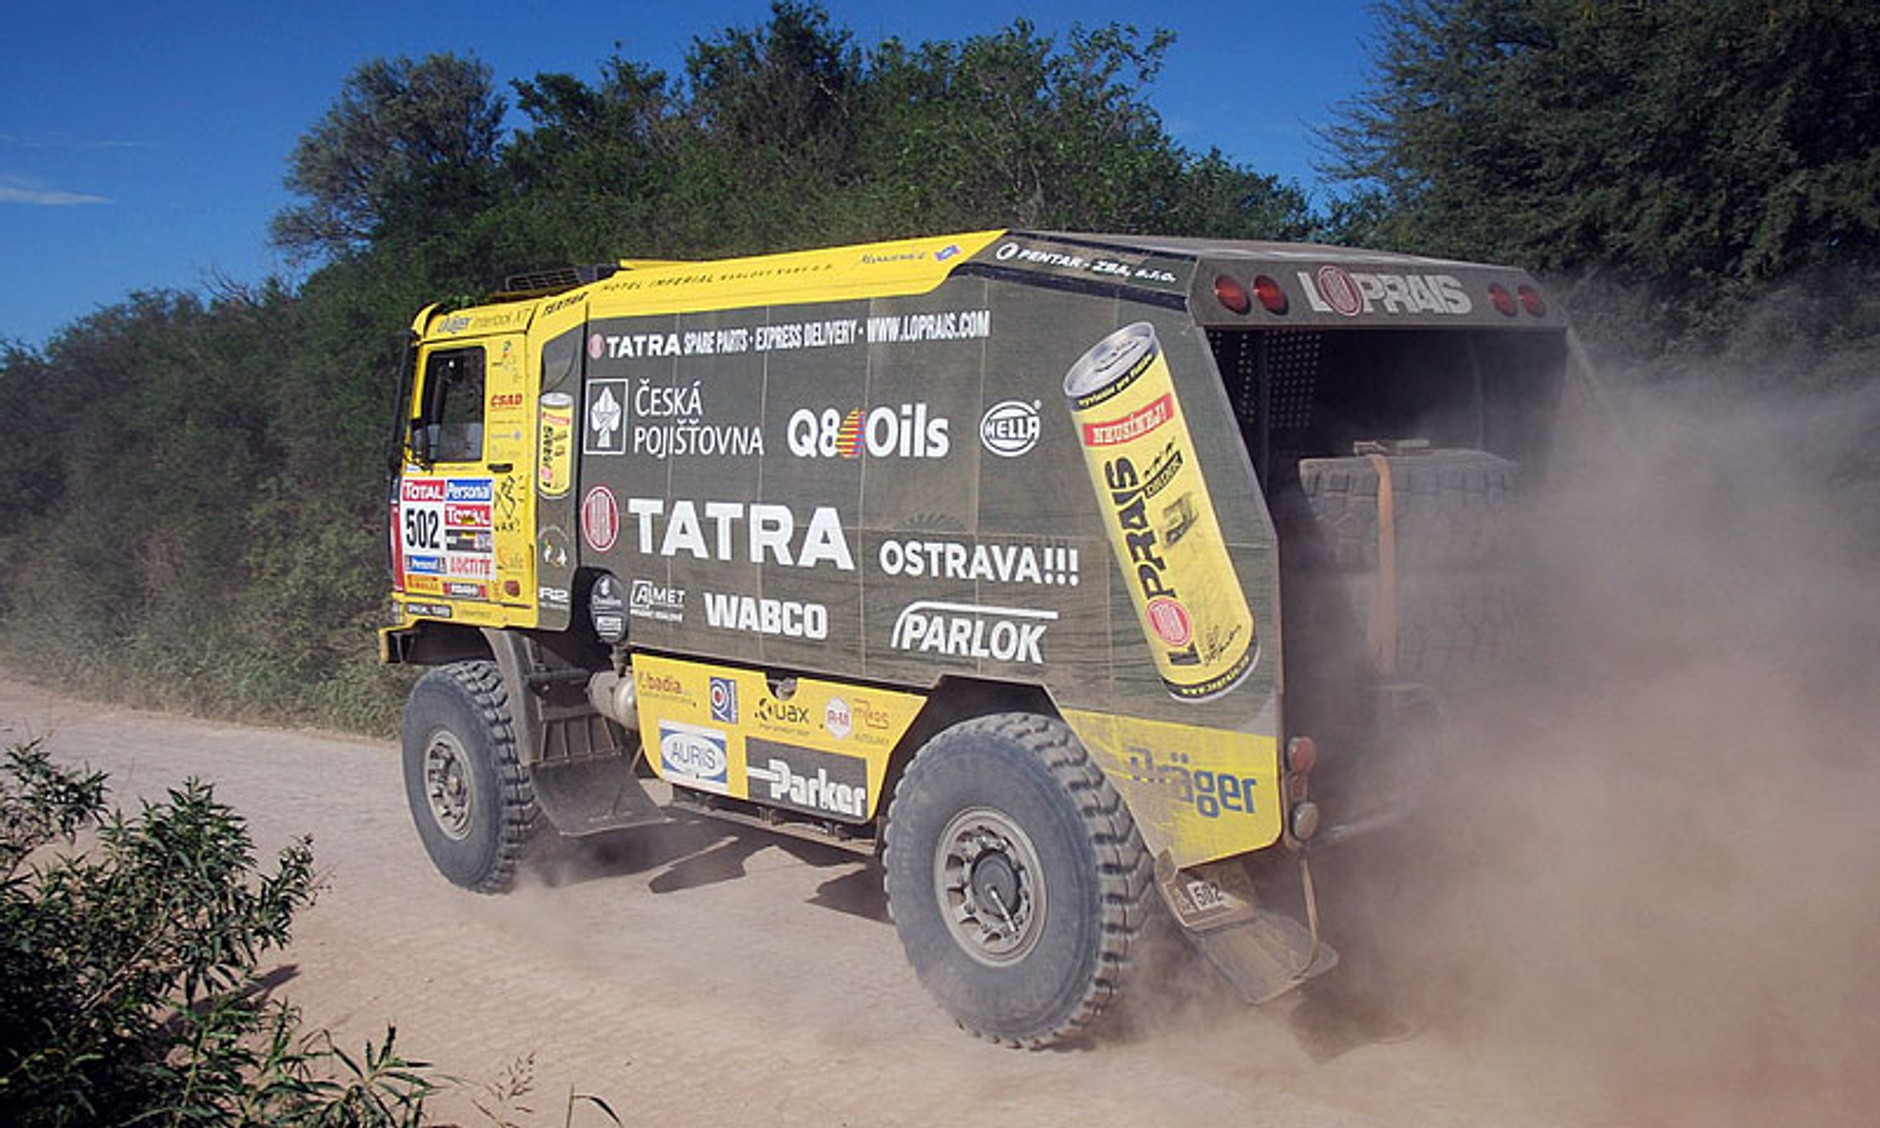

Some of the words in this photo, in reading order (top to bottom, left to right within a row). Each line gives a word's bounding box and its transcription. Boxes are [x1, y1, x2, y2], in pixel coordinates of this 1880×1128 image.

[1297, 264, 1472, 316] LOPRAIS
[605, 333, 682, 359] TATRA
[684, 331, 715, 355] SPARE
[716, 328, 749, 354] PARTS
[755, 323, 801, 351] EXPRESS
[803, 319, 857, 348] DELIVERY
[866, 311, 991, 343] WWW.LOPRAIS.COM
[635, 378, 703, 416] ČESKÁ
[634, 418, 765, 459] POJIŠŤOVNA
[787, 408, 842, 458] Q8
[865, 403, 949, 458] Oils
[984, 415, 1041, 442] HELLA
[404, 481, 445, 499] TOTAL
[447, 480, 492, 500] Personal
[405, 508, 441, 549] 502
[628, 498, 855, 571] TATRA
[879, 540, 1080, 587] OSTRAVA!!!
[703, 592, 828, 640] WABCO
[901, 614, 1047, 664] PARLOK
[671, 741, 717, 770] AURIS
[768, 758, 866, 817] Parker
